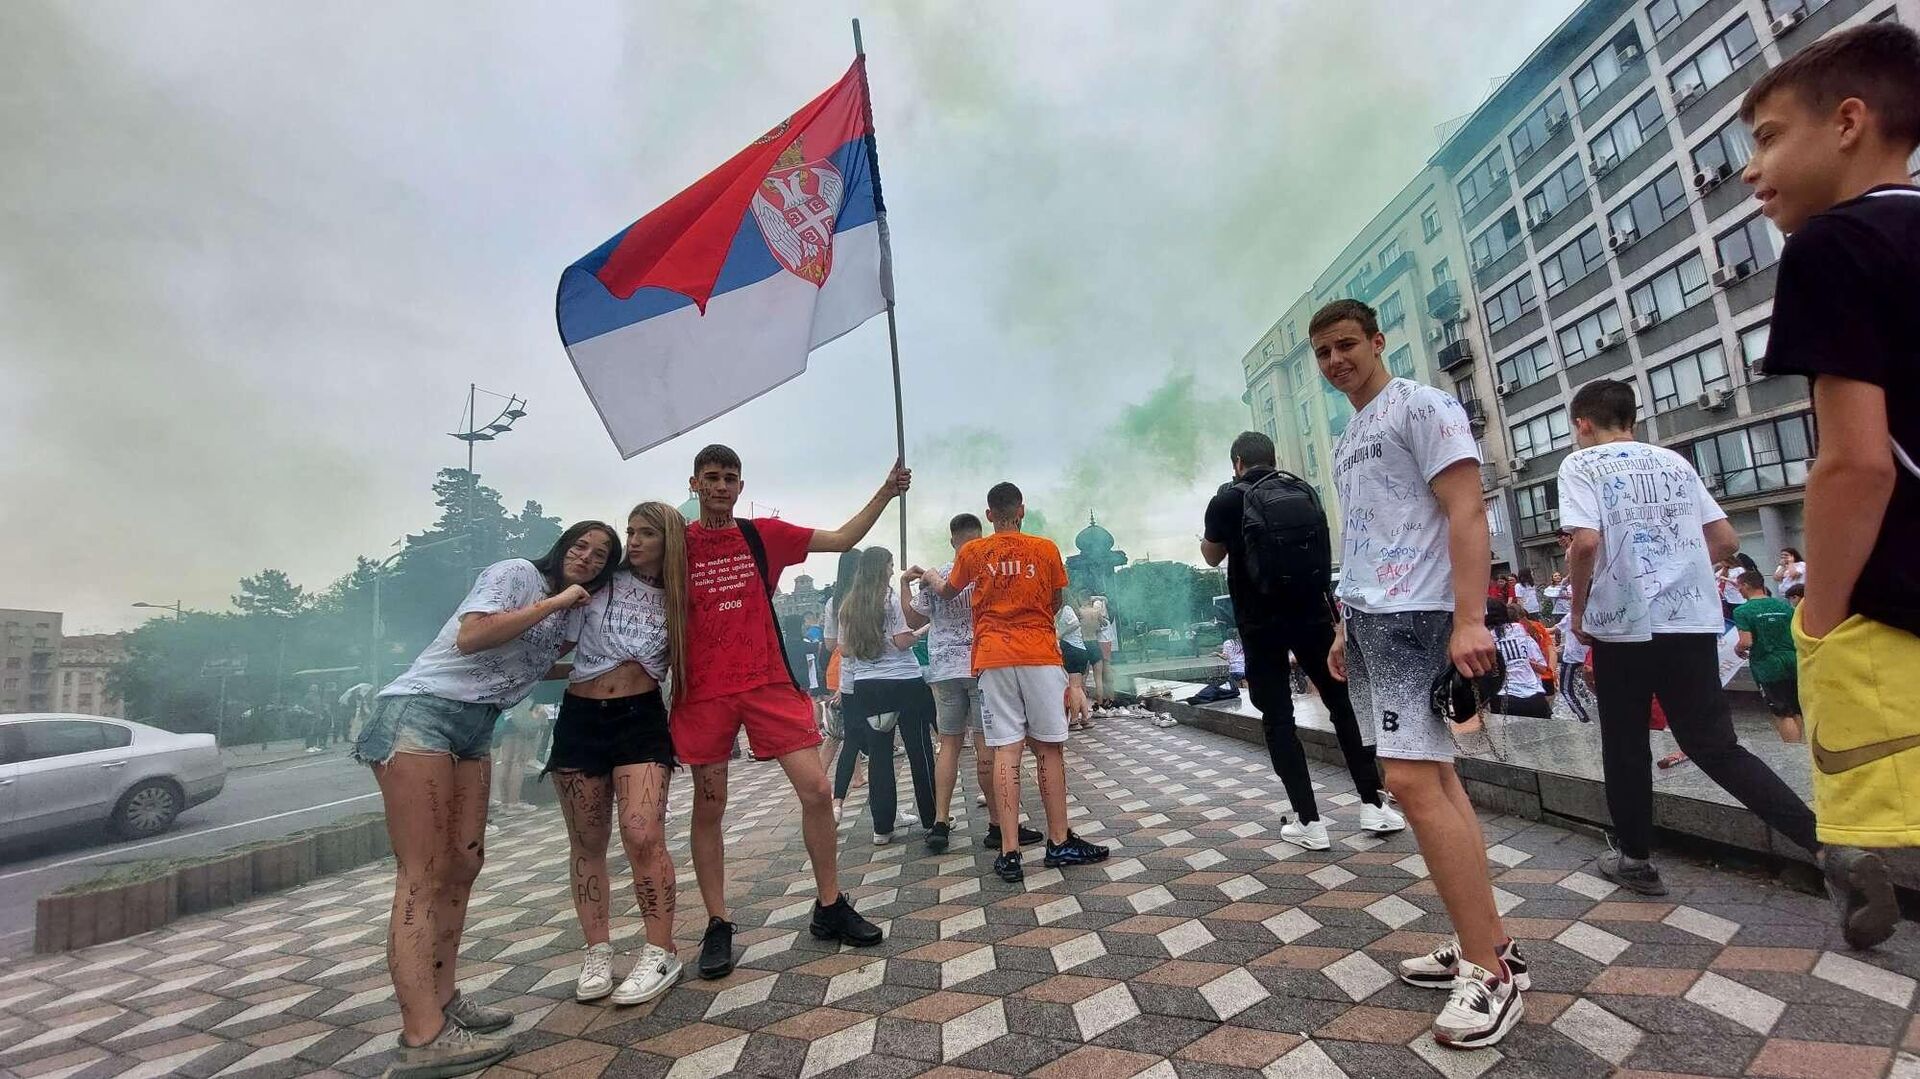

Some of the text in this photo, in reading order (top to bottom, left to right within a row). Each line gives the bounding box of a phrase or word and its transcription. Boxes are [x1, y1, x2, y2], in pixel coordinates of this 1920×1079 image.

[1596, 458, 1664, 477] ГЕНЕРАЦИЈА
[707, 558, 731, 566] možete
[986, 560, 1036, 579] VIII 3
[718, 600, 743, 612] 2008
[1382, 710, 1399, 732] B
